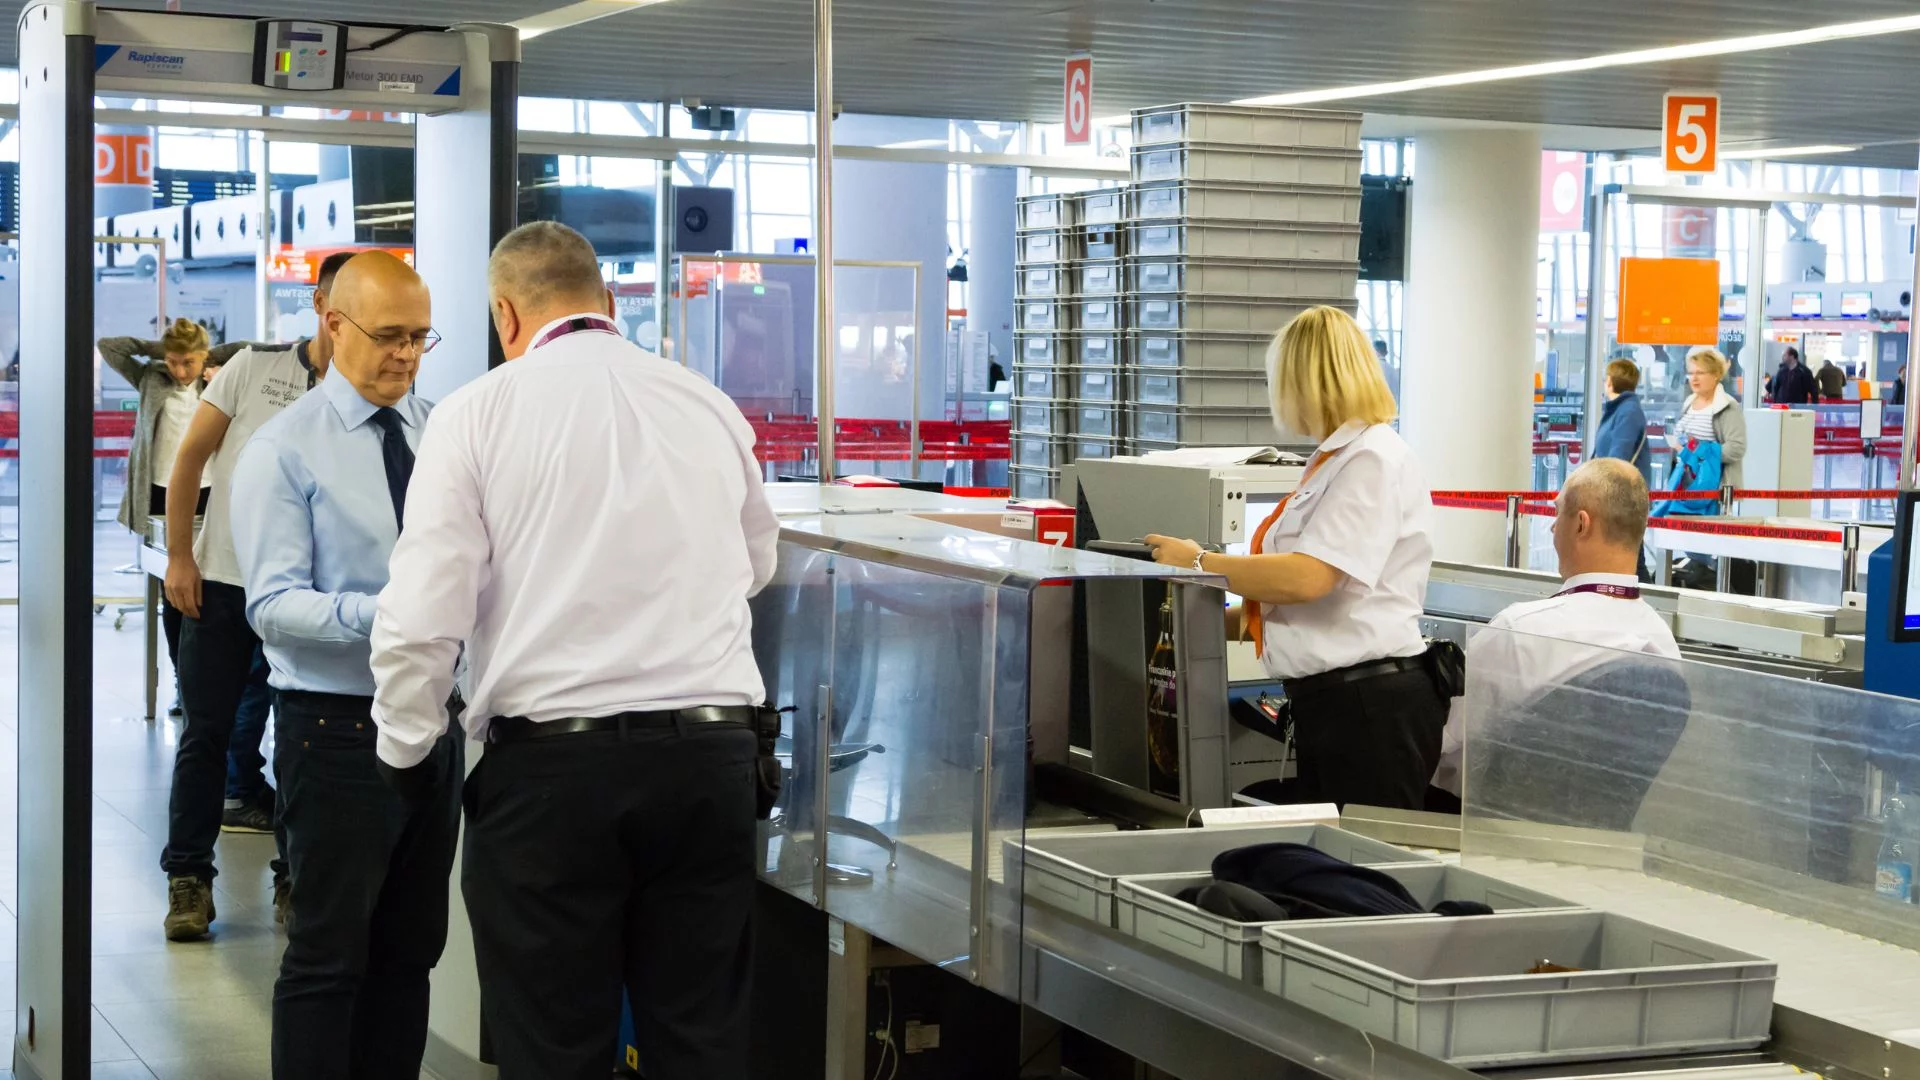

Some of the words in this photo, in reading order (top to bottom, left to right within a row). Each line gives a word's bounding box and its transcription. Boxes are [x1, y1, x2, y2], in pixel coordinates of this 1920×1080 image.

[128, 50, 184, 65] Rapiscan
[345, 71, 375, 81] Metor
[377, 73, 397, 82] 300
[400, 75, 423, 84] EMD
[1069, 67, 1086, 135] 6
[1675, 104, 1707, 165] 5
[1679, 214, 1699, 241] C
[1525, 506, 1542, 515] PORT
[1043, 531, 1068, 556] 7
[1681, 521, 1715, 533] WARSAW
[1758, 528, 1790, 540] CHOPIN
[1791, 531, 1829, 543] AIRPORT
